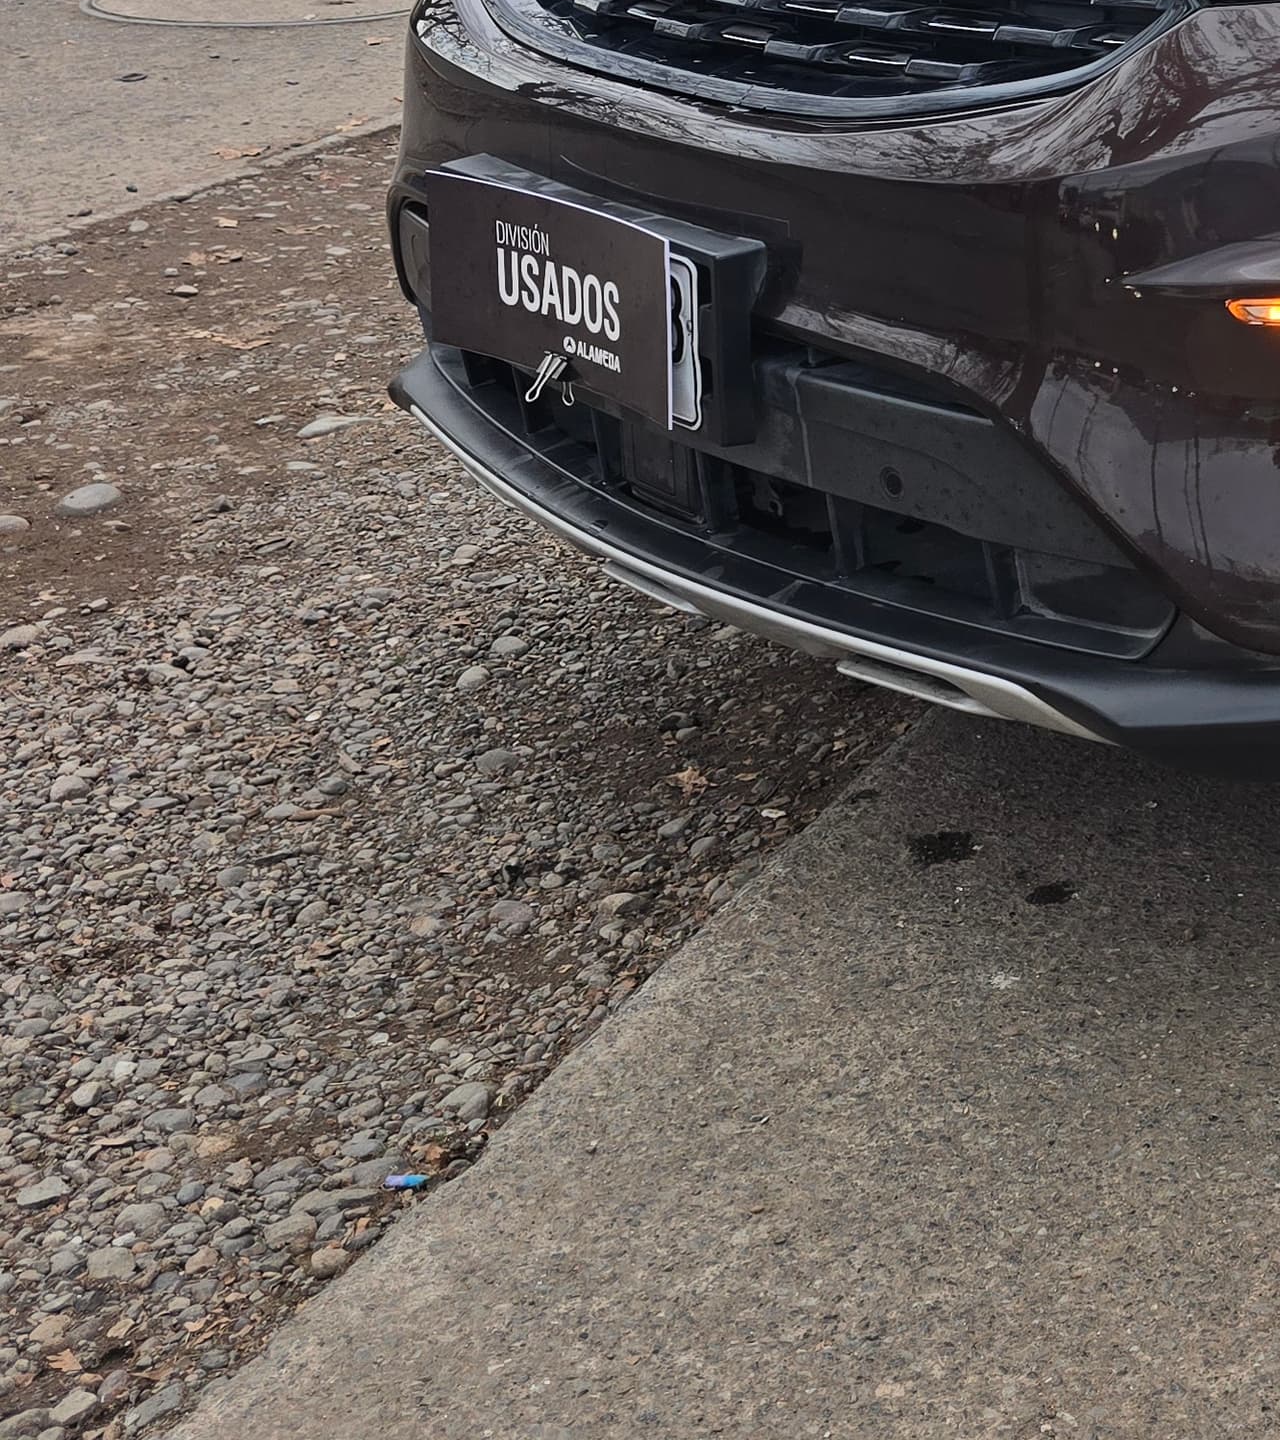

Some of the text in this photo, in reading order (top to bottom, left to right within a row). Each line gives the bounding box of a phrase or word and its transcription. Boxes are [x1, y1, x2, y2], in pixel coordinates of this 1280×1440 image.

[496, 220, 550, 257] DIVISIÓN
[496, 247, 621, 342] USADOS
[576, 340, 622, 373] ALAMEDA
